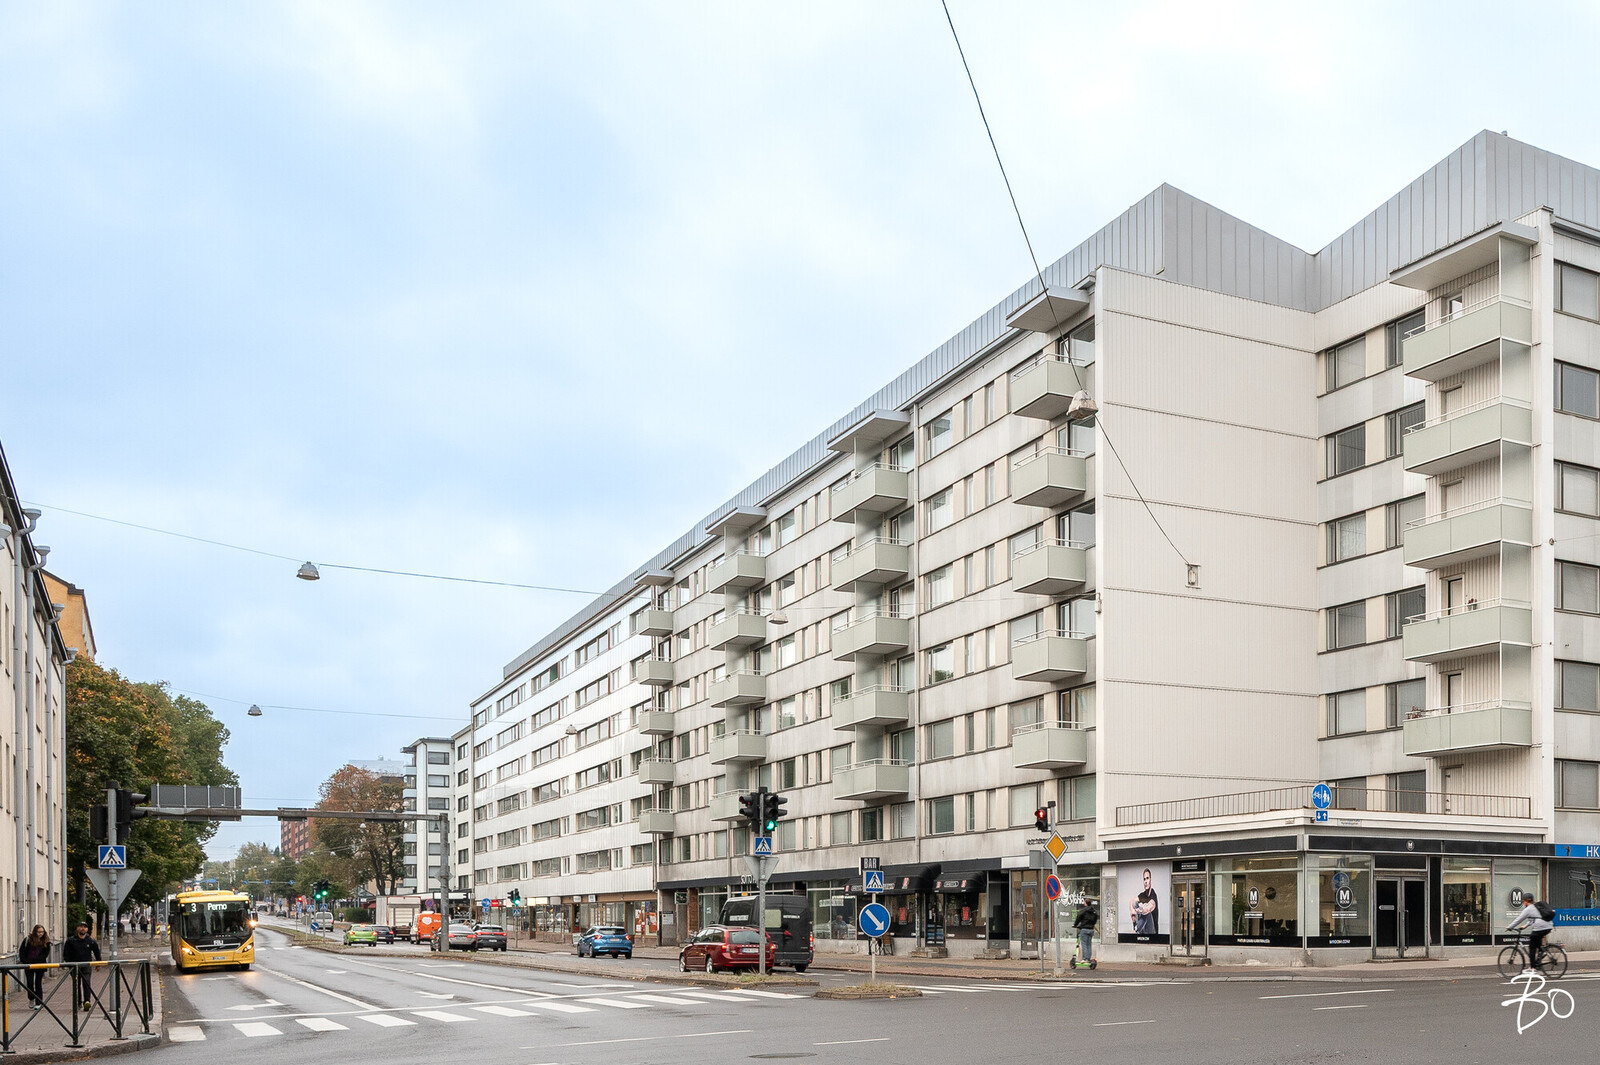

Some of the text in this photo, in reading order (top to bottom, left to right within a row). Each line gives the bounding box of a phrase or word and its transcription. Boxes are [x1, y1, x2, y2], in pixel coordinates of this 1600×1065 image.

[1586, 845, 1600, 857] HK
[863, 858, 877, 869] BAR
[1250, 890, 1258, 901] M
[1340, 890, 1350, 901] M
[1512, 891, 1521, 901] M
[191, 902, 228, 912] 3 Perno
